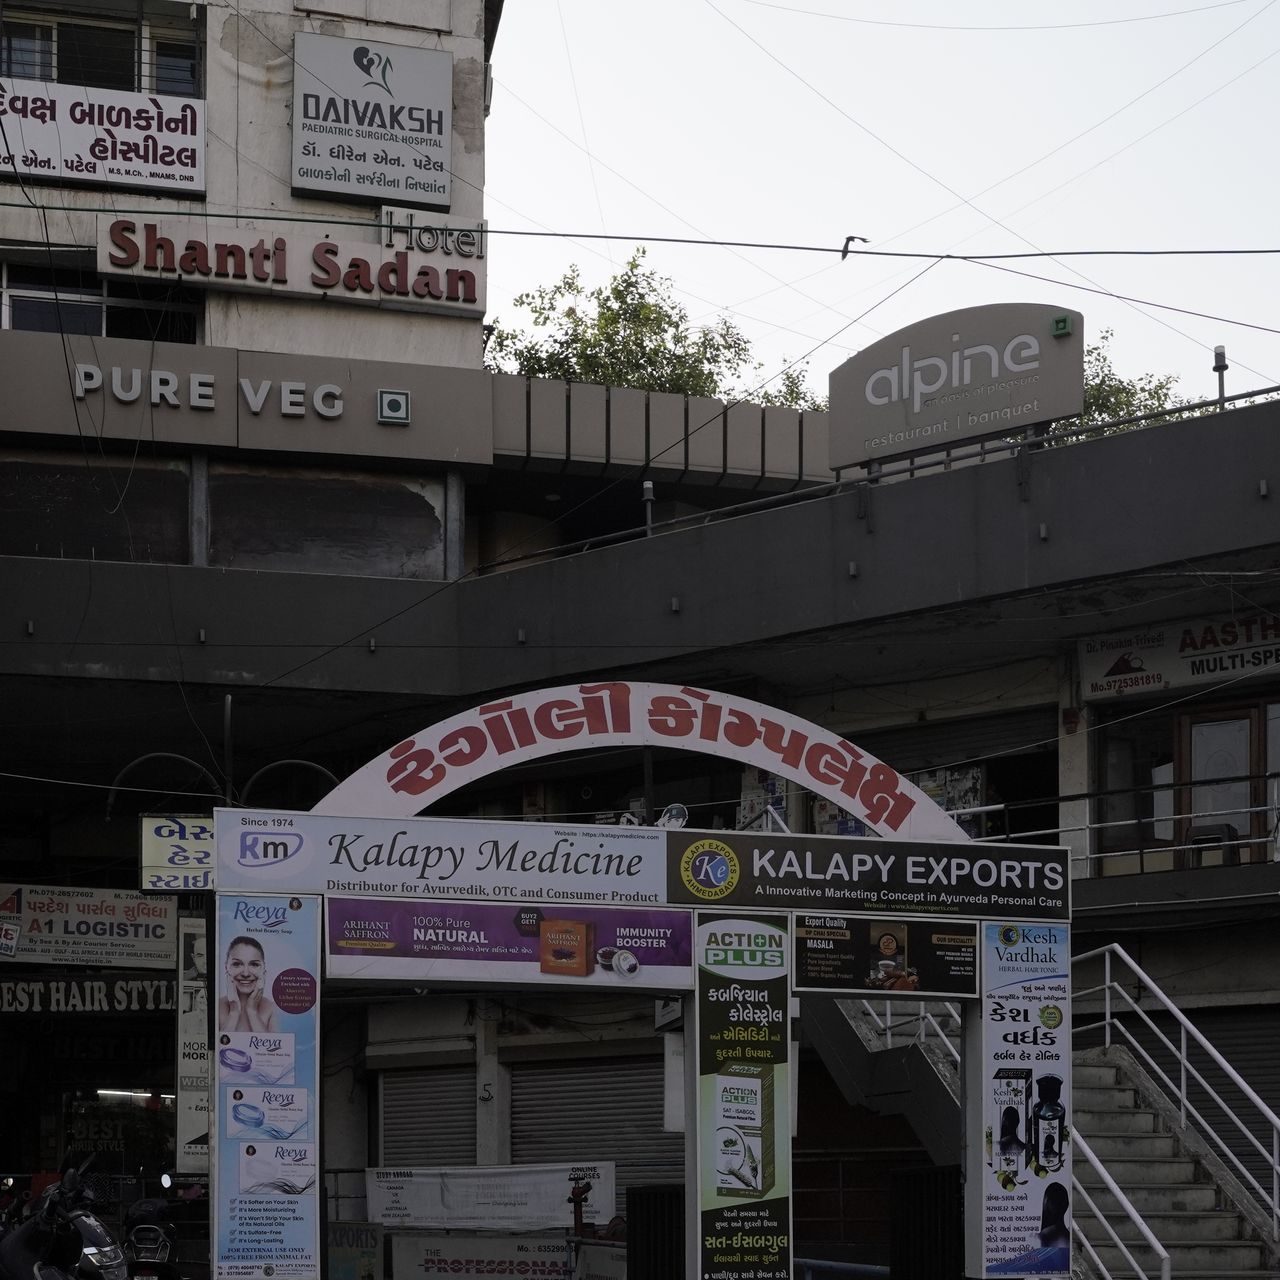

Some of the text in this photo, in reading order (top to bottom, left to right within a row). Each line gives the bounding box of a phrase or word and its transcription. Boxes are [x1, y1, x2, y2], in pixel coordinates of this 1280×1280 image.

[69, 97, 197, 136] બાળકોની
[303, 93, 443, 136] DAIVAKSH
[302, 123, 443, 148] PAEDIATRIC SURGICAL HOSPITAL
[89, 128, 197, 168] હોસ્પીટલ
[385, 210, 484, 259] Hotel
[109, 218, 478, 304] Shanti Sadan
[865, 333, 1040, 414] alpine
[75, 362, 345, 420] PURE VEG
[864, 400, 1040, 449] restaurant banquet
[387, 681, 630, 797] રંગોલી
[241, 817, 293, 828] Since 1974
[328, 830, 643, 880] Kalapy Medicine
[753, 849, 1064, 890] KALAPY EXPORTS
[327, 880, 659, 902] Distributor for Ayurvedik, OTC and Consumer Product
[755, 885, 1062, 907] A Innovative Marketing Concept in Ayurveda Personal Care
[234, 901, 287, 923] Reeya
[413, 916, 470, 928] 100% Pure
[27, 919, 53, 934] A1
[64, 919, 166, 938] LOGISTIC
[343, 920, 391, 930] ARIHANT
[344, 930, 389, 939] SAFFRON
[413, 928, 488, 944] NATURAL
[617, 927, 672, 938] IMMUNITY
[617, 938, 666, 948] BOOSTER
[706, 932, 783, 948] ACTION
[1021, 929, 1057, 944] Kesh
[706, 949, 783, 967] PLUS
[995, 946, 1057, 963] Vardhak
[50, 981, 109, 1012] HAIR
[990, 1001, 1031, 1022] કેશ
[425, 1249, 441, 1257] THE
